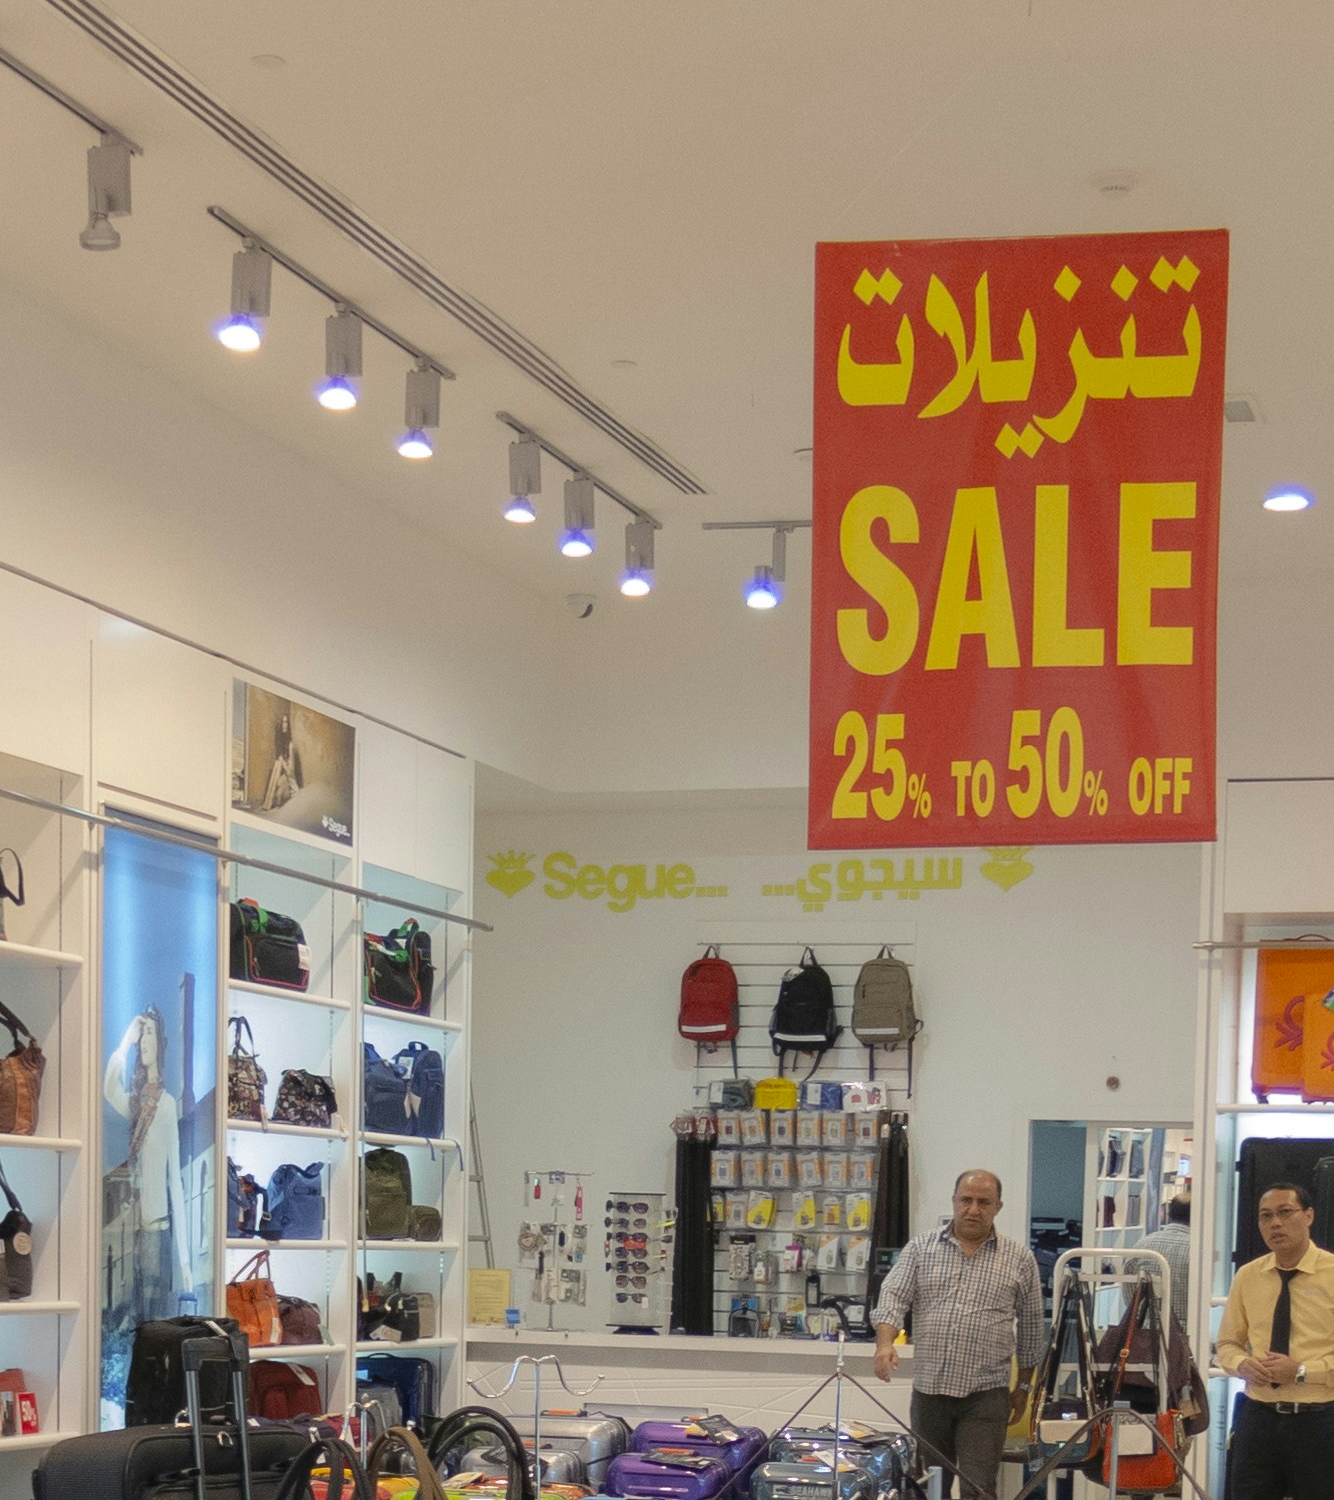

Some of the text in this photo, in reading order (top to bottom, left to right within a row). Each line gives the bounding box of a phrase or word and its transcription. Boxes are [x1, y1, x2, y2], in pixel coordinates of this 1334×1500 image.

[836, 255, 1202, 459] تنزيلات
[836, 481, 1198, 677] SALE
[831, 706, 1193, 822] 25% TO 50% OFF
